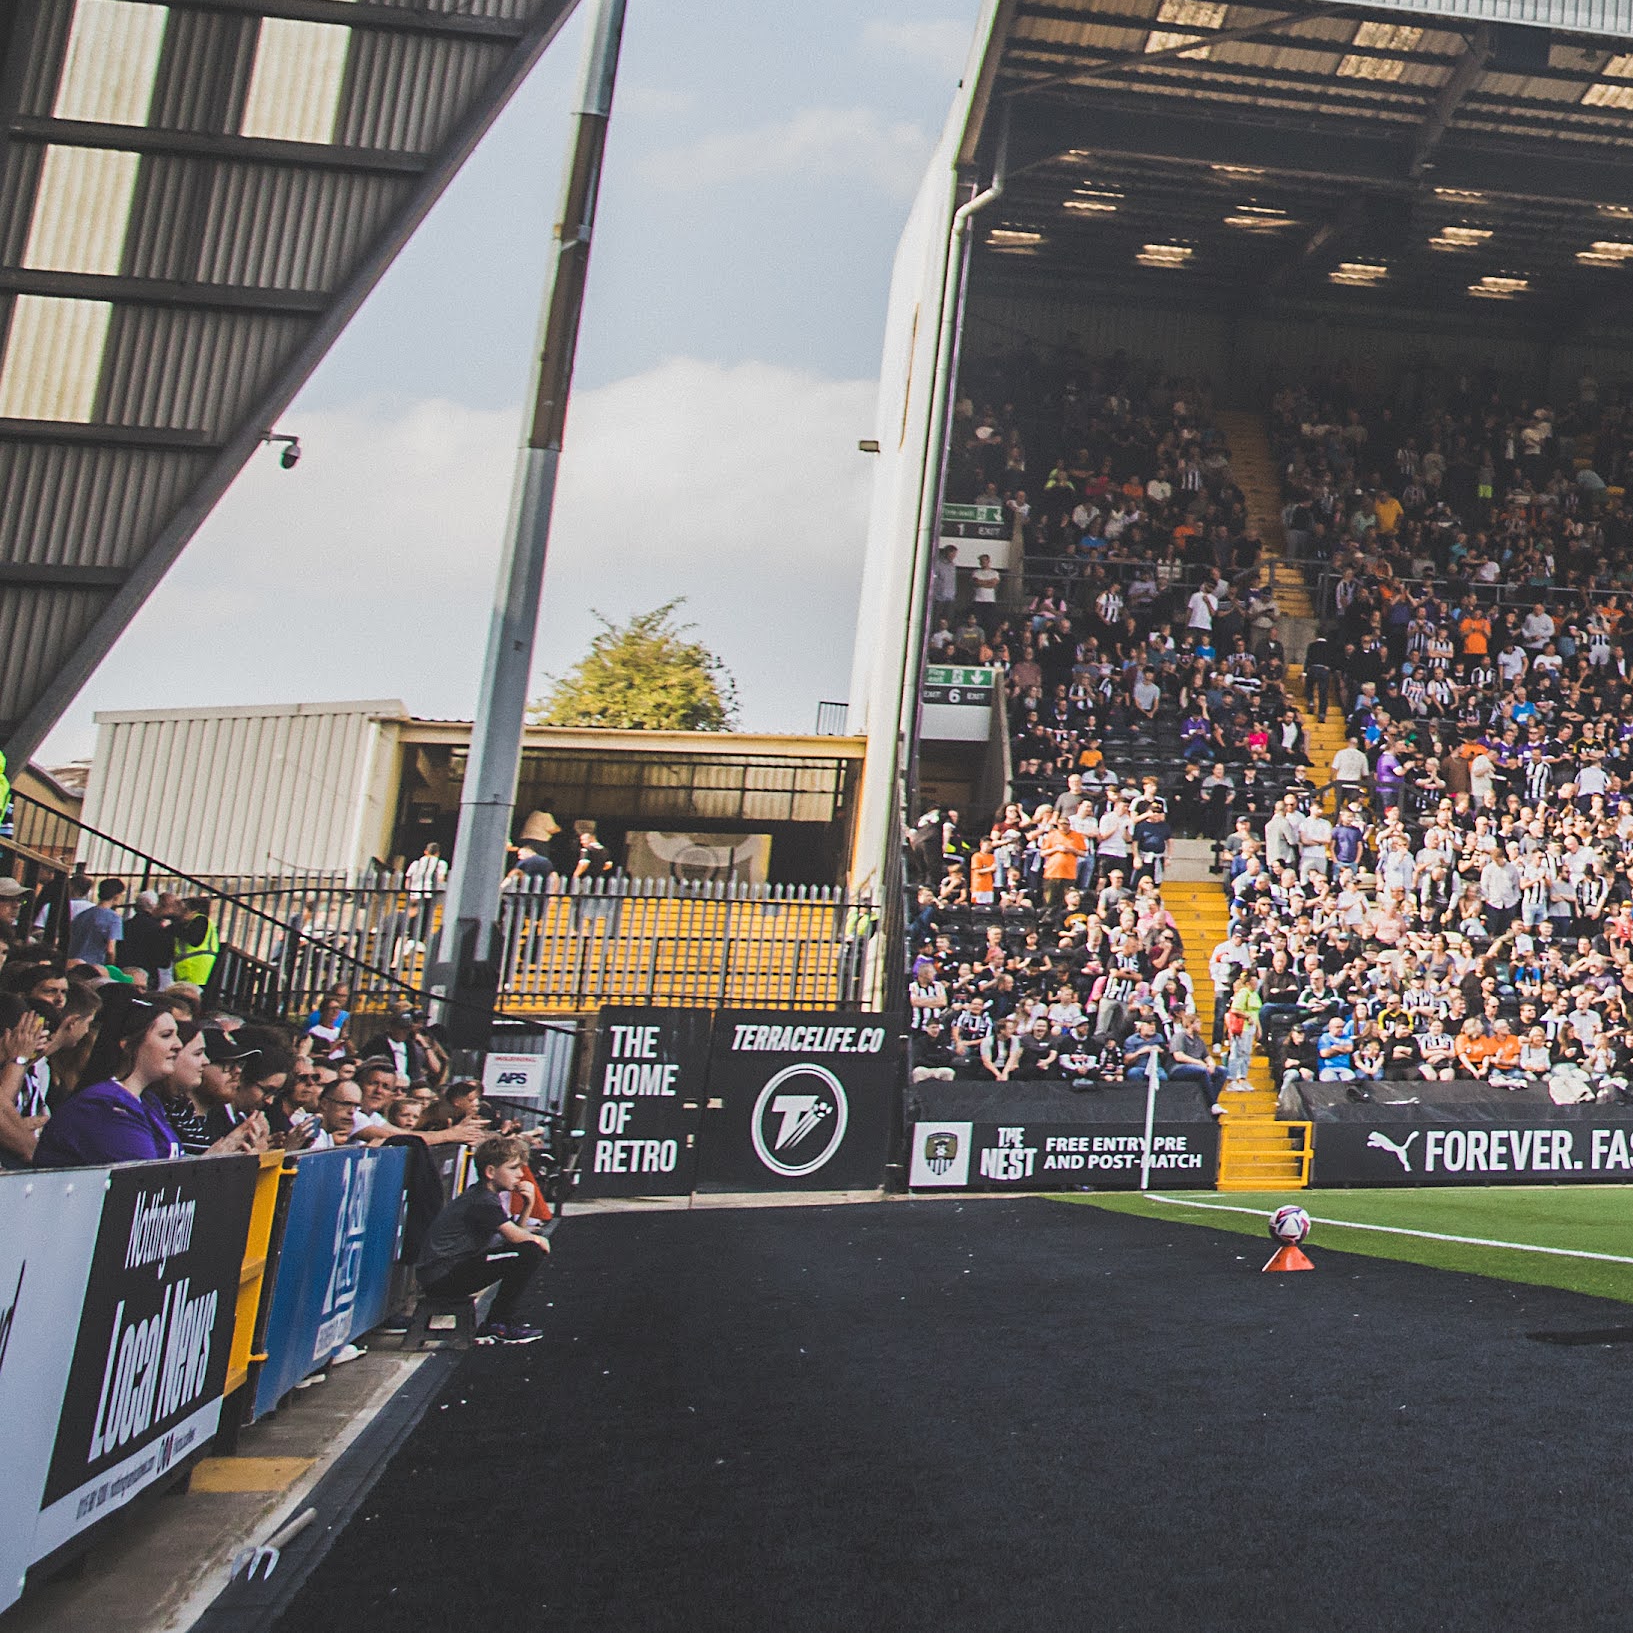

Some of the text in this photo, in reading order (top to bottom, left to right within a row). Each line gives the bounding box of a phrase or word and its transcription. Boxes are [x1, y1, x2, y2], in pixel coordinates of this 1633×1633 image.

[948, 688, 961, 703] 6
[610, 1025, 660, 1059] THE
[731, 1024, 886, 1053] TERRACELIFE.CO
[496, 1072, 527, 1085] APS
[602, 1063, 680, 1097] HOME
[598, 1101, 636, 1135] OF
[997, 1127, 1025, 1148] THE
[1046, 1136, 1187, 1152] FREE ENTRY PRE
[1425, 1130, 1583, 1172] FOREVER.
[593, 1139, 678, 1173] RETRO
[980, 1148, 1038, 1181] NEST
[1043, 1153, 1203, 1170] AND POST-MATCH
[125, 1185, 196, 1280] Nottingham
[88, 1277, 218, 1464] Local News
